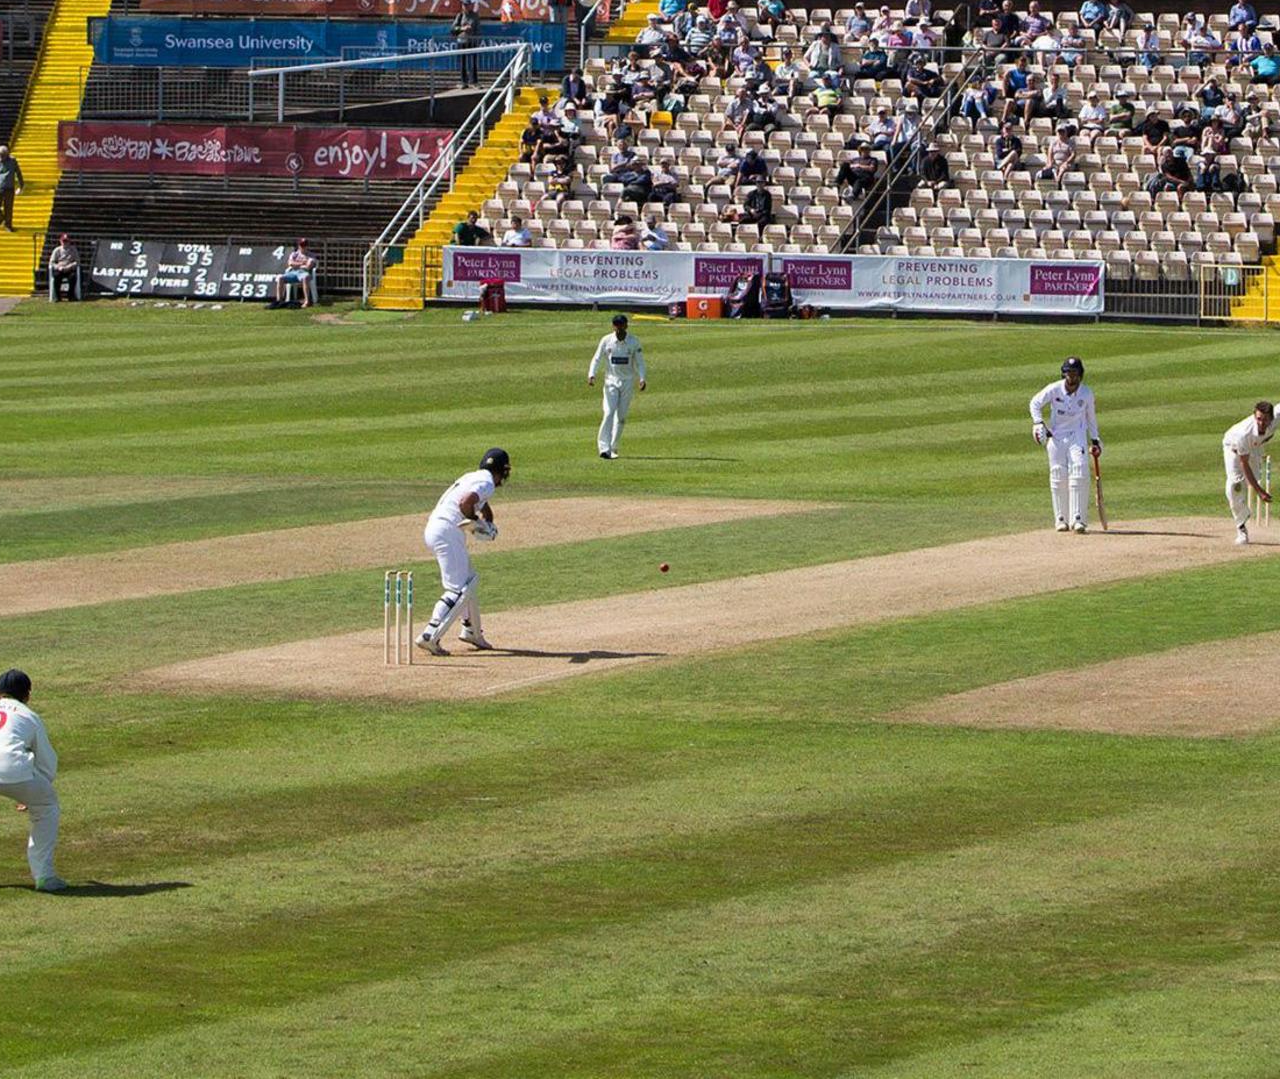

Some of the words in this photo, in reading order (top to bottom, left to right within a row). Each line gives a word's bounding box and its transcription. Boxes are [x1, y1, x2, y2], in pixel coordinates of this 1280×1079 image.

[164, 33, 234, 50] Swansea
[238, 34, 314, 53] University
[314, 132, 388, 175] enjoy!
[130, 241, 142, 255] 3
[177, 244, 213, 253] TOTAL
[272, 246, 285, 259] 4
[135, 254, 147, 269] 5
[457, 256, 483, 269] Peter
[487, 257, 516, 272] Lynn
[566, 255, 644, 267] PREVENTING
[897, 261, 978, 274] PREVENTING
[93, 267, 122, 277] LAST
[123, 269, 148, 278] MAN
[158, 263, 191, 273] WKTS
[194, 269, 208, 282] 2
[466, 268, 517, 279] PARTNERS
[549, 267, 588, 279] LEGAL
[593, 269, 659, 281] PROBLEMS
[699, 261, 727, 273] Peter
[730, 262, 759, 276] Lynn
[787, 263, 815, 275] Peter
[818, 264, 847, 279] Lynn
[223, 272, 252, 282] LAST
[796, 275, 847, 287] PARTNERS
[882, 275, 921, 285] LEGAL
[926, 275, 993, 287] PROBLEMS
[1034, 269, 1063, 281] Peter
[1066, 270, 1095, 286] Lynn
[150, 277, 190, 287] OVERS
[194, 282, 217, 296] 38
[228, 283, 268, 298] 283
[1044, 281, 1094, 292] PARTNERS
[698, 300, 708, 310] G
